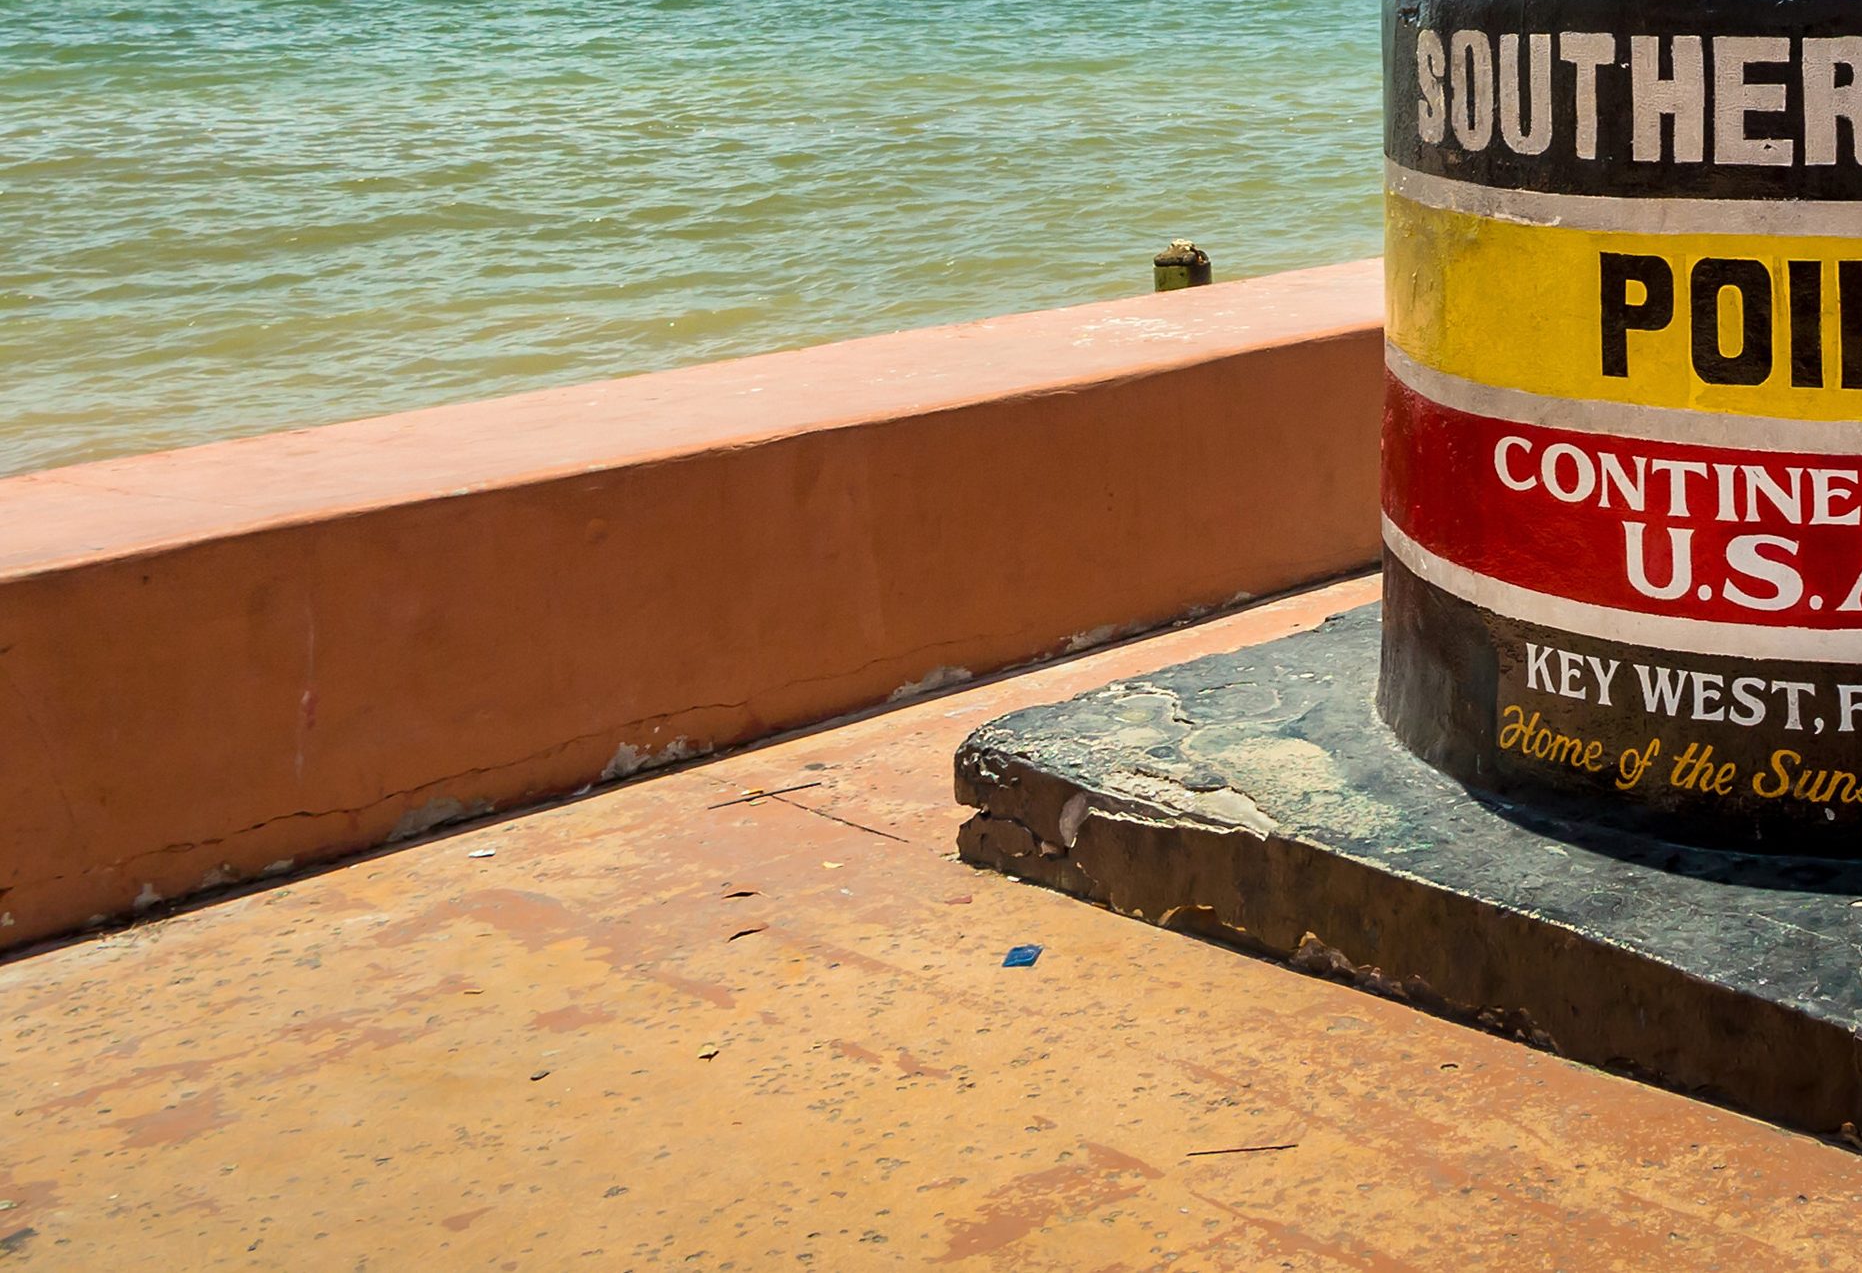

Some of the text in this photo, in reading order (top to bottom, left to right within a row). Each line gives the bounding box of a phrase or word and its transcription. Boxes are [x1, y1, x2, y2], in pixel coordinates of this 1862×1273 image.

[1525, 642, 1620, 705] KEY
[1634, 664, 1823, 735] WEST,
[1499, 705, 1603, 772] Home
[1615, 739, 1659, 789] of
[1670, 742, 1736, 795] the
